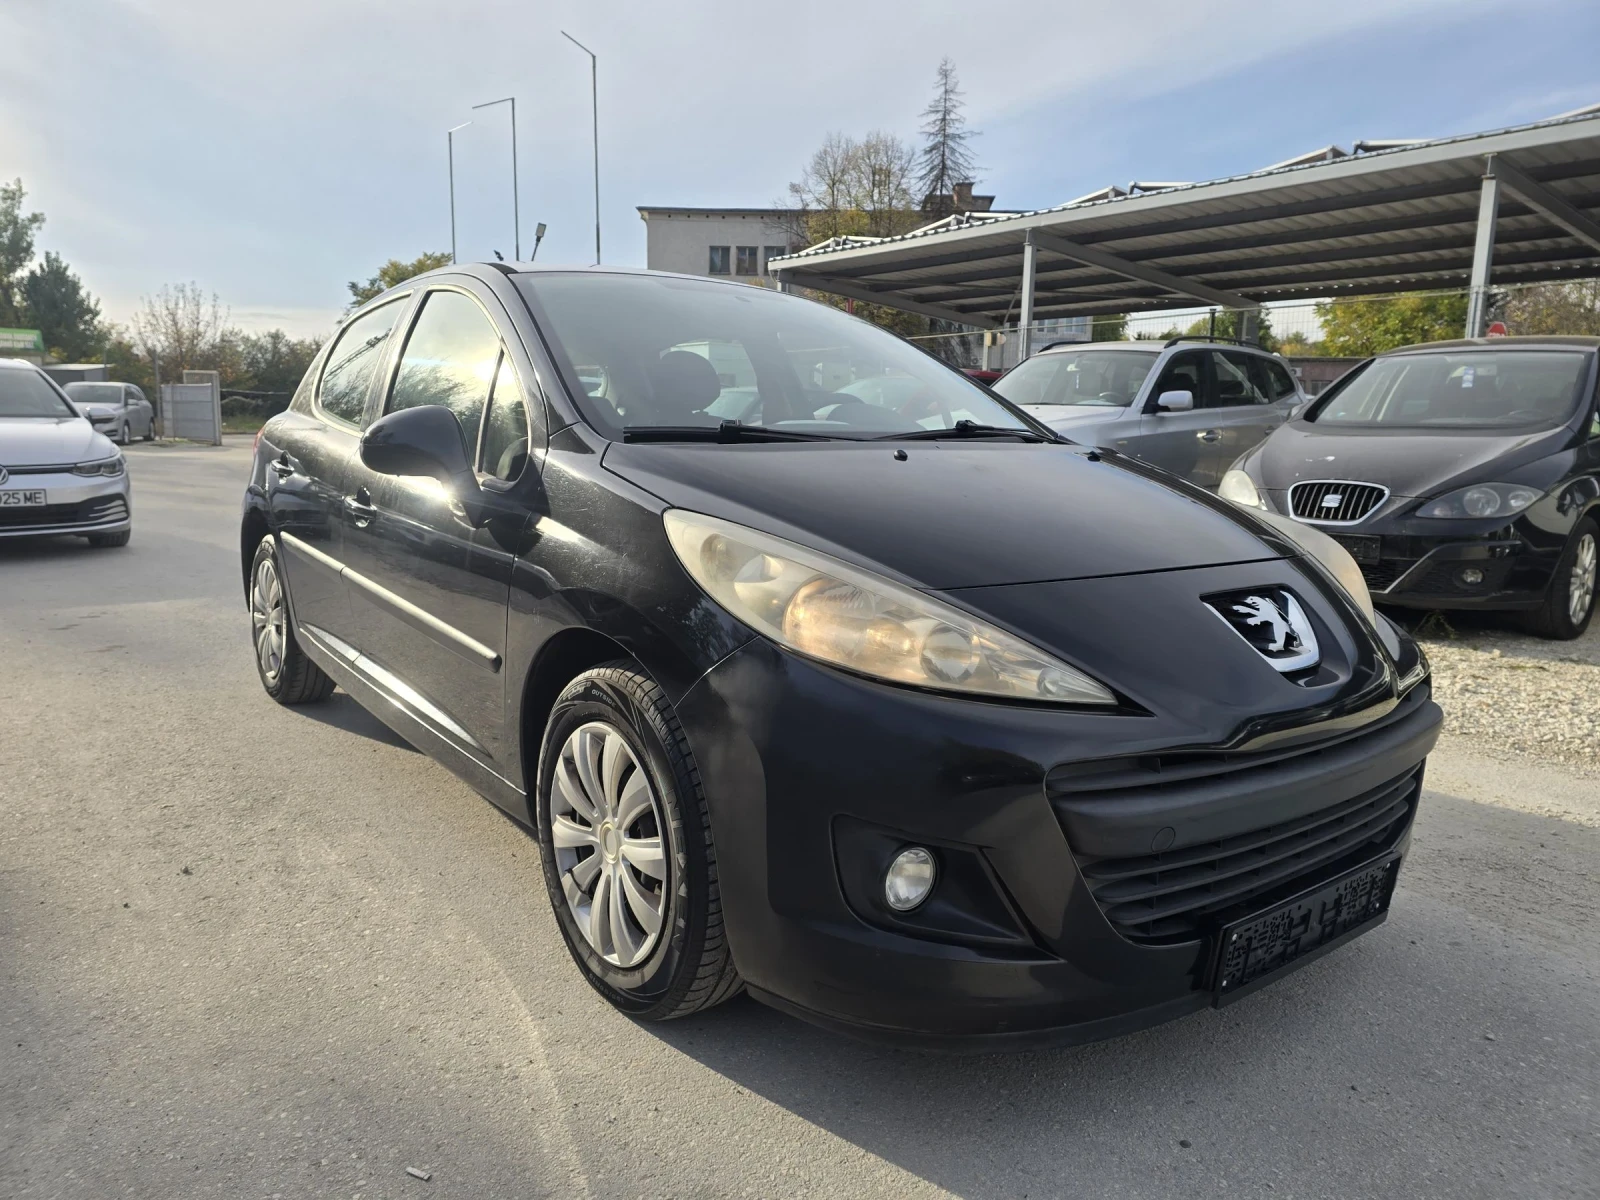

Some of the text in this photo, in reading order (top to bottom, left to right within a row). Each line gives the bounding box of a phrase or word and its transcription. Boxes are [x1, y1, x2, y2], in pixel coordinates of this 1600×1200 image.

[0, 491, 43, 505] 25 ME
[591, 689, 616, 707] OUTSIDE
[664, 788, 688, 954] NEXEN
